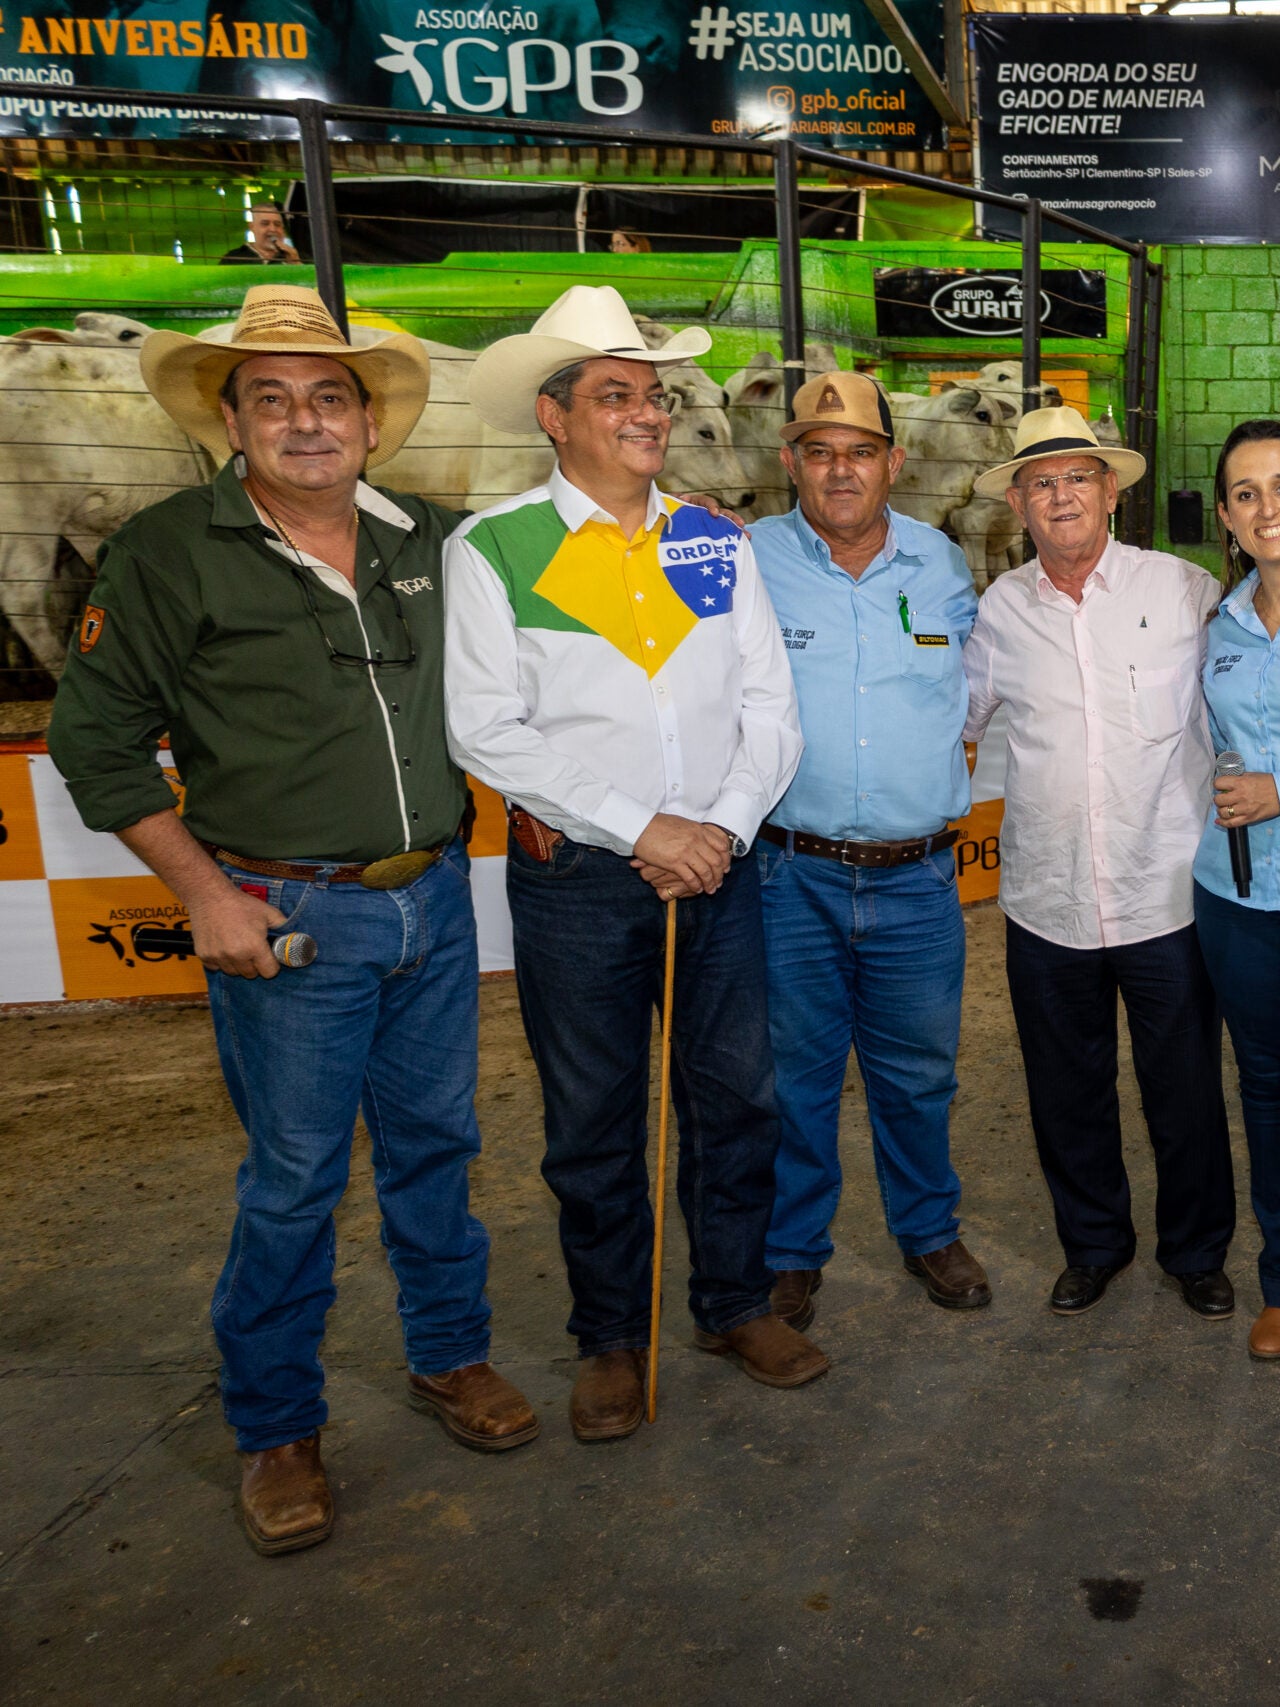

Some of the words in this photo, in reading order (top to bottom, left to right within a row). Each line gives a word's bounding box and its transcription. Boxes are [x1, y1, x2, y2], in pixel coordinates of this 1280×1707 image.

[415, 6, 539, 35] ASSOCIAÇÃO
[811, 13, 851, 38] UM
[18, 13, 308, 59] ANIVERSÁRIO
[442, 37, 644, 116] GPB
[997, 63, 1109, 83] ENGORDA
[1114, 63, 1148, 83] DO
[1151, 63, 1197, 83] SEU
[801, 88, 906, 115] gpb_oficial
[999, 89, 1065, 109] GADO
[1067, 89, 1099, 108] DE
[1102, 89, 1206, 108] MANEIRA
[999, 114, 1122, 135] EFICIENTE!
[1002, 155, 1099, 165] CONFINAMENTOS
[1002, 167, 1080, 178] Sertãozinho-SP
[1086, 167, 1161, 178] Clementina-SP
[1167, 168, 1213, 178] Sales-SP
[953, 289, 994, 300] GRUPO
[944, 301, 1024, 319] JURIT
[957, 836, 1000, 877] PB
